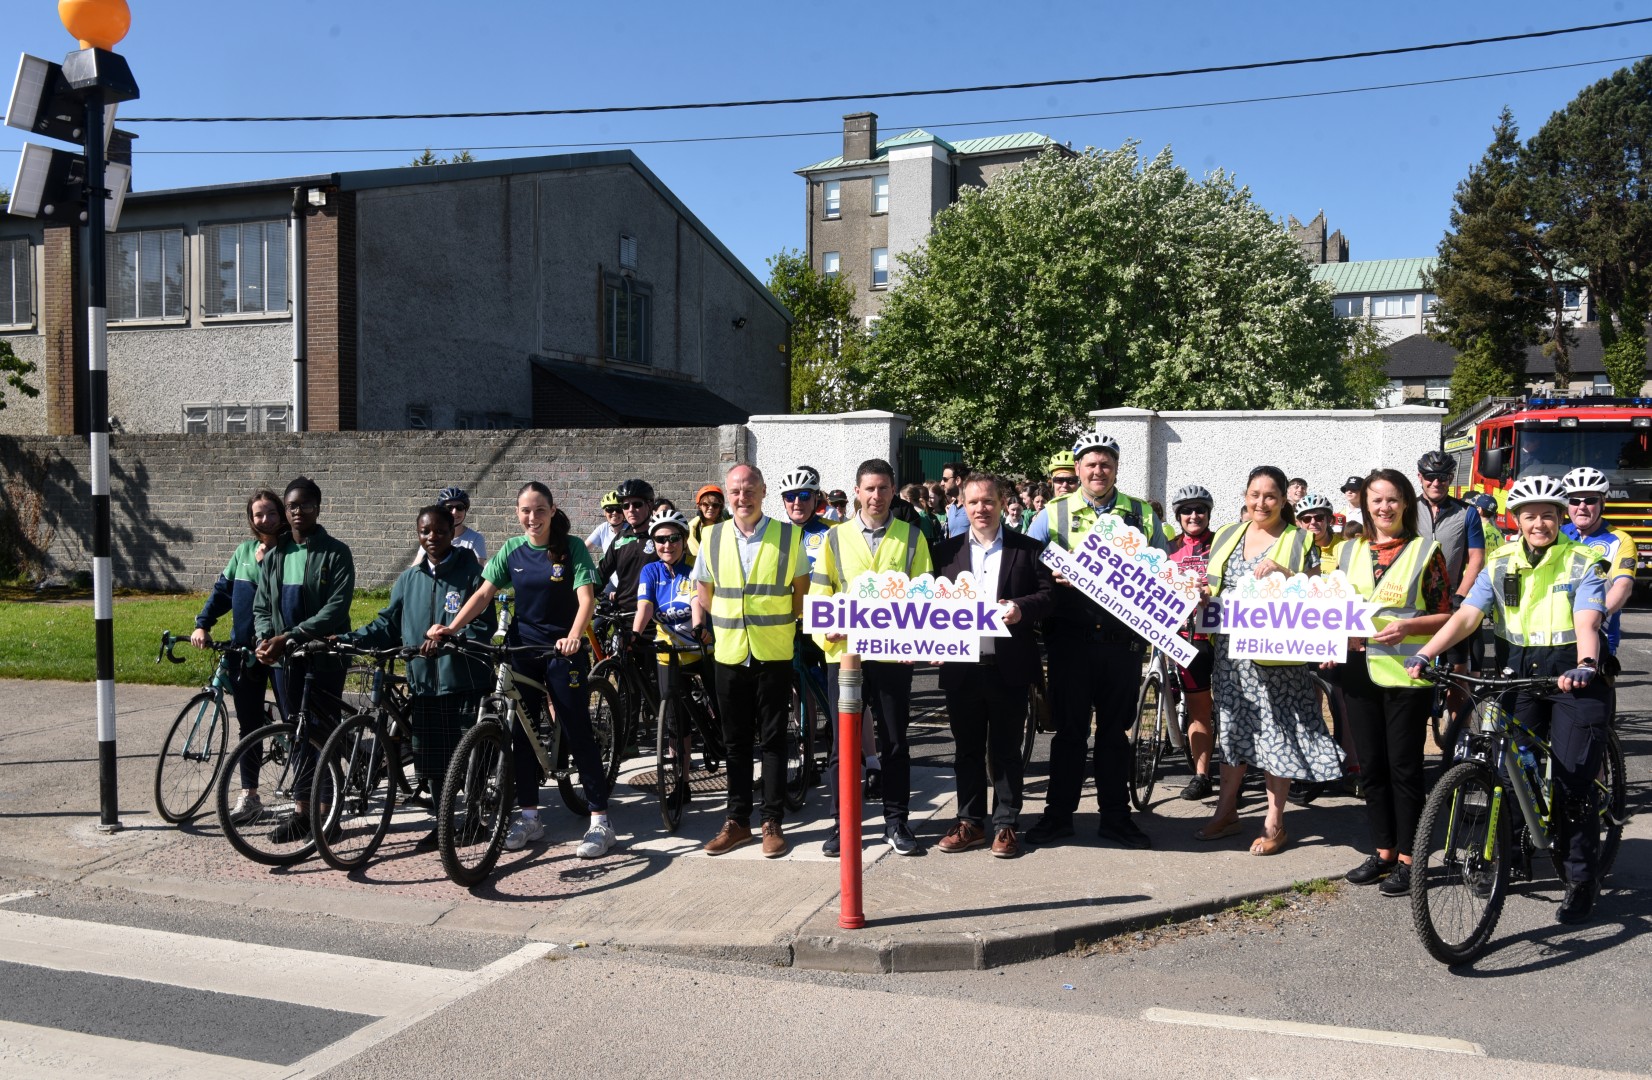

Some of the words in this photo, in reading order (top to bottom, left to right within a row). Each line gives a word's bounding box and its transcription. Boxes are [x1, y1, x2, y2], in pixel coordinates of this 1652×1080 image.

[1604, 490, 1630, 499] NIA
[1083, 533, 1186, 615] Seachtain
[1383, 581, 1403, 592] Think
[1076, 552, 1104, 577] na
[1105, 570, 1179, 629] Rothar
[1379, 588, 1402, 599] Farm
[811, 598, 998, 631] BikeWeek
[1042, 549, 1191, 662] #SeachtainnaRothar
[1202, 599, 1367, 631] BikeWeek
[856, 639, 971, 656] #BikeWeek
[1236, 638, 1338, 656] #BikeWeek
